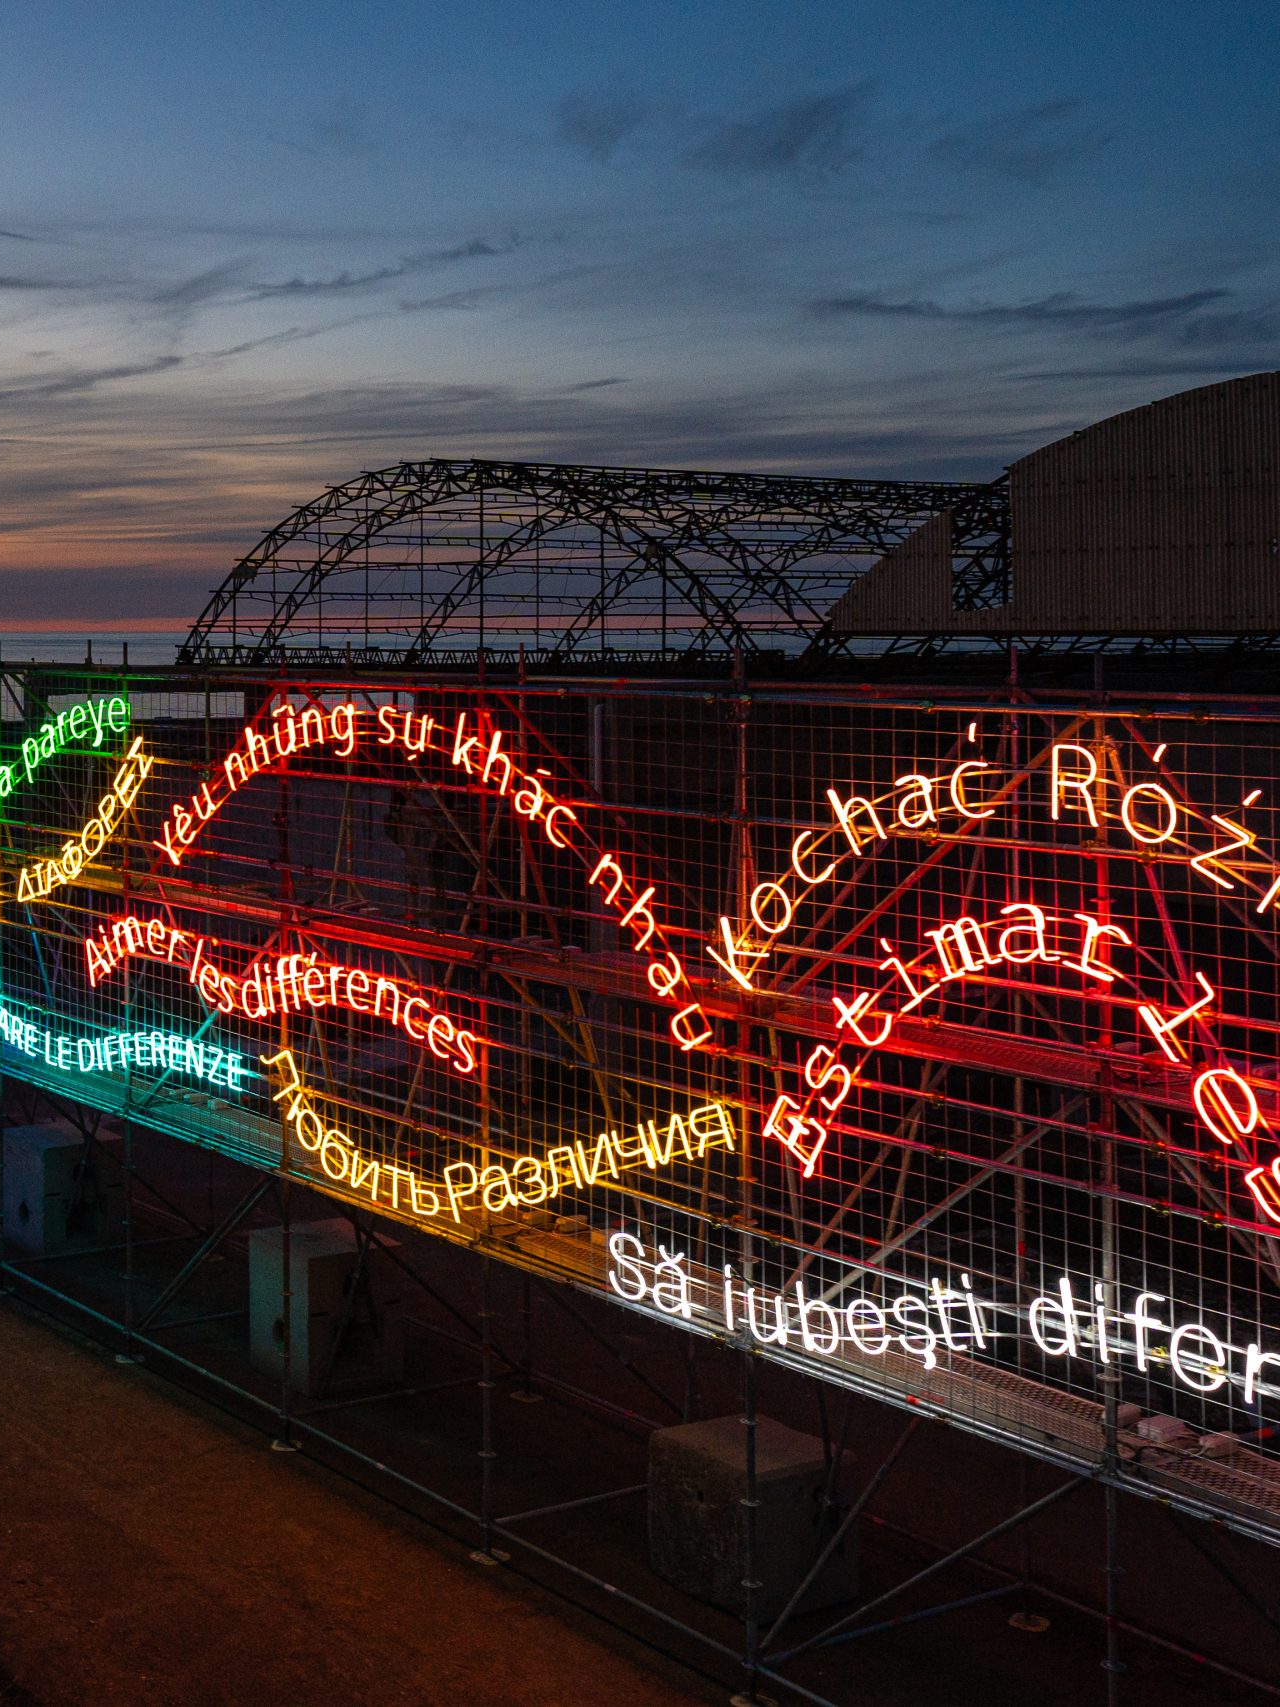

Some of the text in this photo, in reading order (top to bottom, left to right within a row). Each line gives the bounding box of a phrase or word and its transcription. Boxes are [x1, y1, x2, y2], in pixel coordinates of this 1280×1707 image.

[22, 697, 128, 783] pareye
[452, 712, 577, 848] khác
[589, 853, 713, 1051] nhau
[44, 1035, 72, 1071] LE
[77, 1030, 245, 1092] DIFFERENZE
[85, 915, 478, 1073] Aimer les différences
[761, 902, 1132, 1178] Estimar
[259, 1049, 440, 1216] Любить
[608, 1232, 692, 1319] Să
